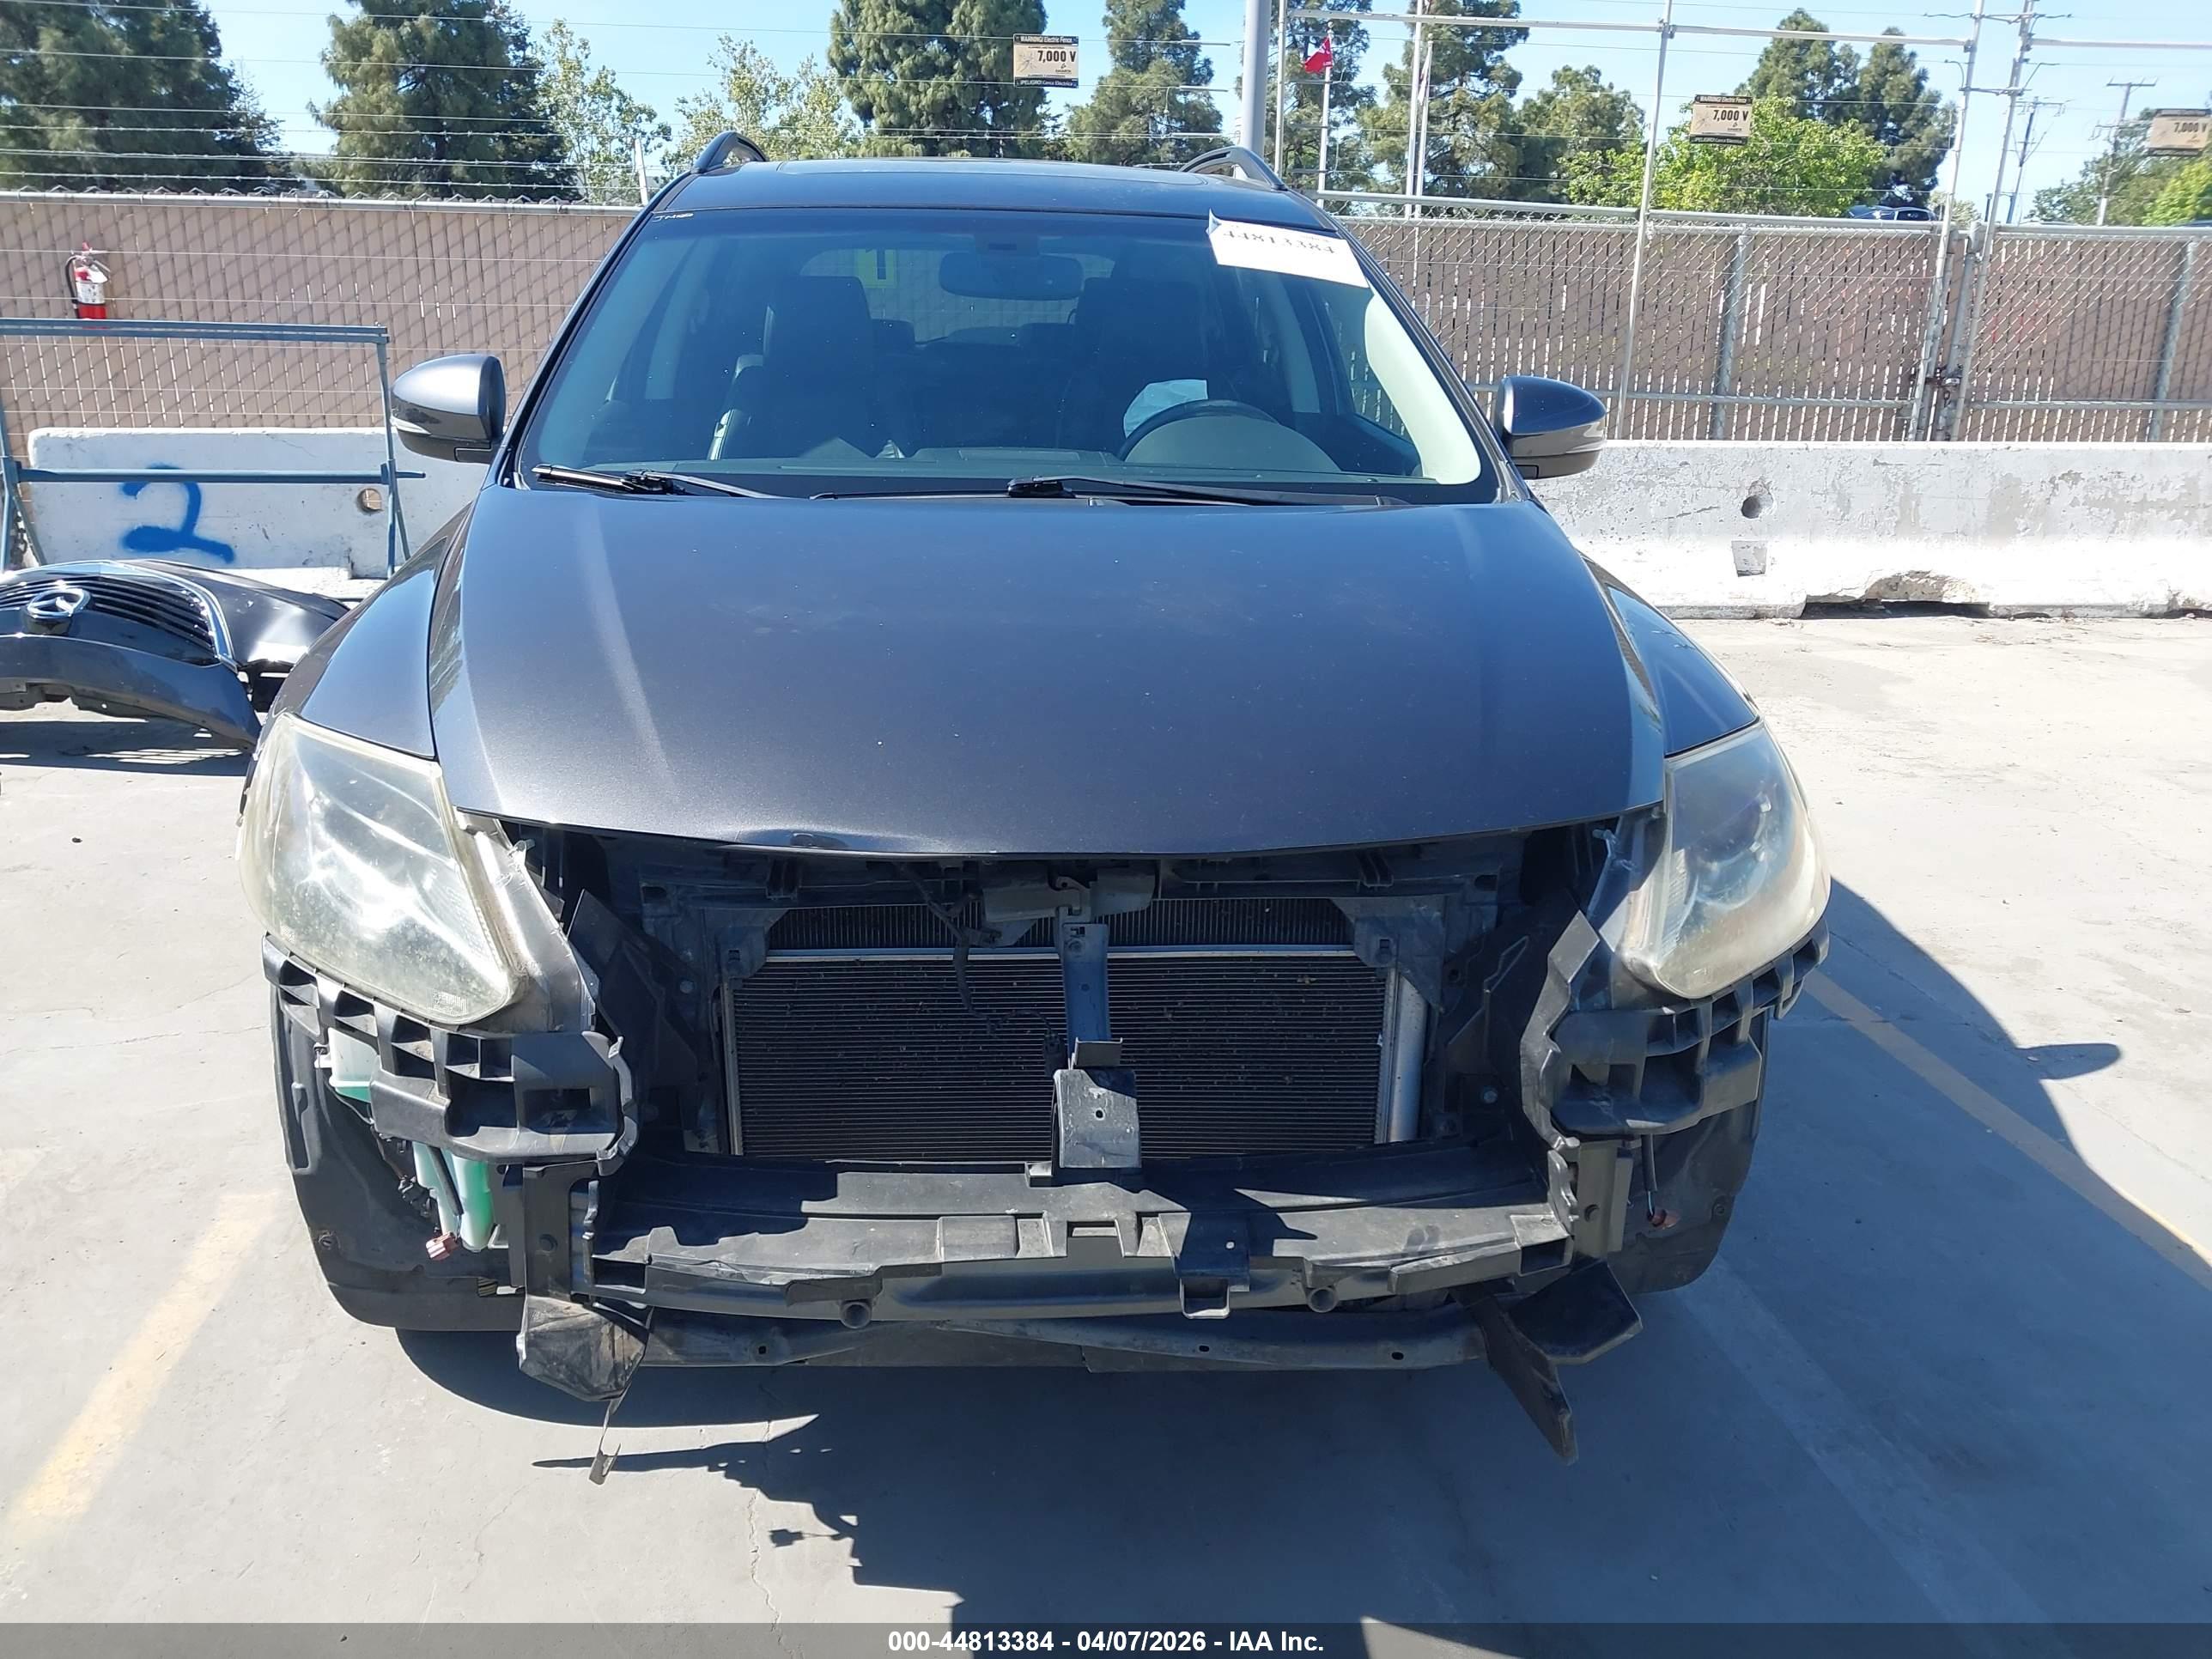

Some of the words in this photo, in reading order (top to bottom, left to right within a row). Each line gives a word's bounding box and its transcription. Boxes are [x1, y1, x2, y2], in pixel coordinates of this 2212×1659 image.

[1037, 50, 1066, 64] 7,000
[1070, 51, 1076, 63] V
[1713, 109, 1740, 122] 7,000
[1743, 110, 1749, 122] V
[2173, 122, 2199, 133] 7,000
[120, 463, 236, 565] 2
